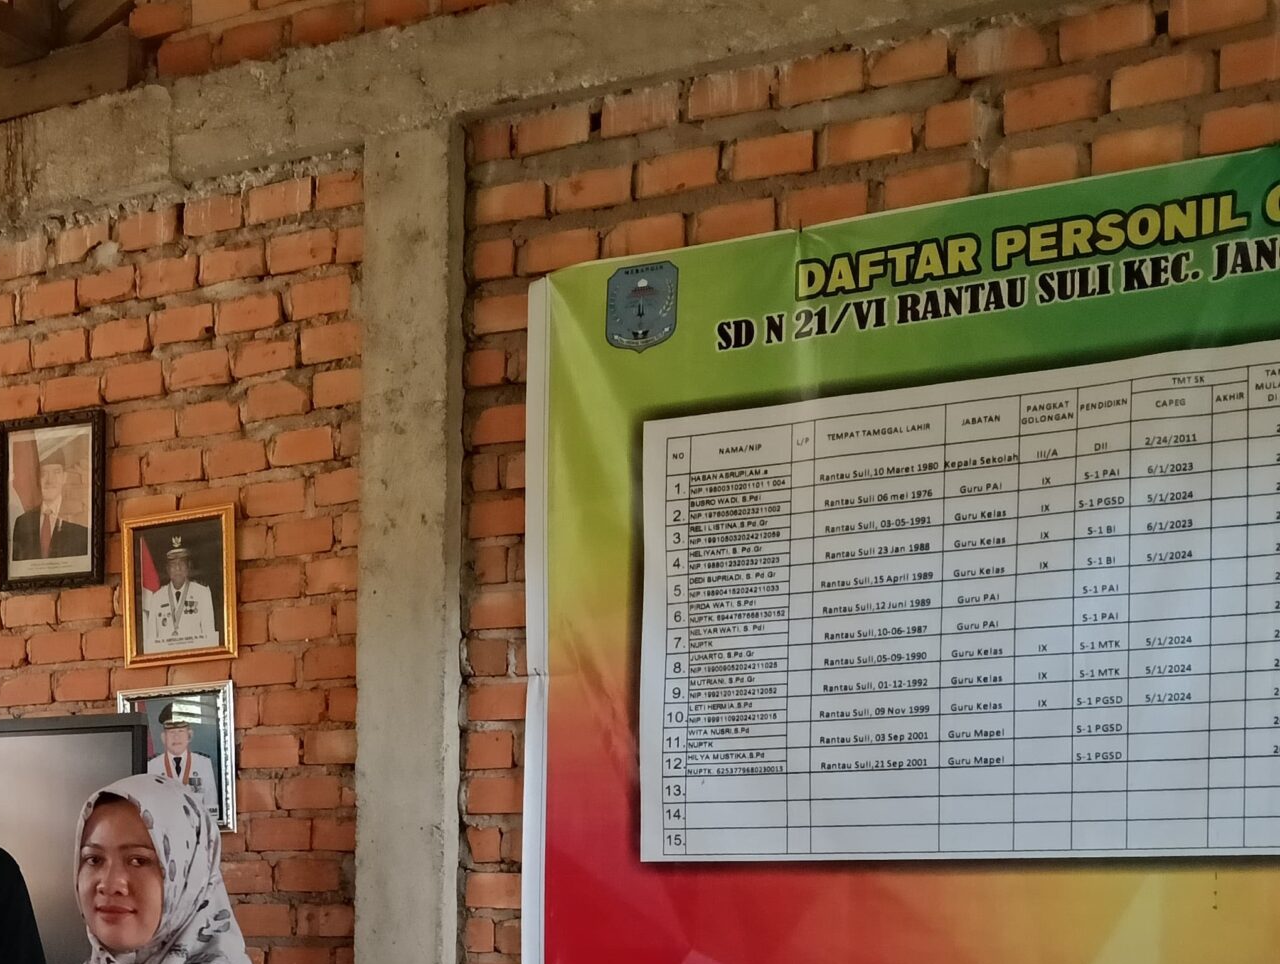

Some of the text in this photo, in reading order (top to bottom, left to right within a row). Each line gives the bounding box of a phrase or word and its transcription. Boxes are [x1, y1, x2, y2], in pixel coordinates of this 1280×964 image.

[797, 235, 979, 299] DAFTAR
[994, 193, 1249, 268] PERSONIL
[717, 318, 755, 350] SD
[766, 314, 784, 343] N
[794, 297, 886, 339] 21/VI
[897, 277, 1026, 324] RANTAU
[1038, 263, 1111, 304] SULI
[1122, 251, 1200, 292] KEC.
[1172, 375, 1205, 384] TMT SK
[1216, 392, 1244, 402] AKHIR
[1027, 401, 1070, 412] PANGKAT
[1155, 399, 1186, 408] CAPEG
[962, 415, 1000, 426] JABATAN
[1021, 412, 1074, 425] GOLONGAN
[827, 431, 859, 441] TEMPAT
[906, 423, 930, 432] LAHIR
[1145, 434, 1197, 446] 2/24/2011
[719, 444, 762, 455] NAMA/NIP
[944, 454, 1018, 469] Kepala Sekolah
[820, 472, 850, 481] Rantau
[887, 466, 914, 475] Maret
[917, 462, 938, 472] 1980
[1148, 462, 1193, 474] 6/1/2023
[960, 485, 982, 494] Guru
[825, 498, 854, 507] Rantau
[858, 495, 875, 504] Suli
[878, 493, 888, 502] 06
[912, 490, 933, 498] 1976
[1097, 496, 1124, 507] PGSD
[1147, 491, 1193, 502] 5/1/2024
[955, 510, 1006, 521] Guru Kelas
[825, 524, 855, 533] Rantau
[880, 516, 931, 528] 03-05-1991
[1147, 519, 1193, 531] 6/1/2023
[954, 537, 1006, 548] Guru Kelas
[825, 551, 855, 560] Rantau
[858, 547, 875, 556] Suli
[909, 542, 930, 551] 1988
[1147, 550, 1193, 562] 5/1/2024
[953, 566, 1005, 578] Guru Kelas
[821, 579, 850, 588] Rantau
[887, 574, 909, 583] April
[912, 572, 933, 580] 1989
[957, 595, 980, 604] Guru
[822, 606, 852, 614] Rantau
[910, 599, 931, 607] 1989
[957, 622, 979, 631] Guru
[824, 632, 854, 640] Rantau
[1146, 636, 1192, 647] 5/1/2024
[1098, 639, 1120, 649] MTK
[951, 647, 1003, 657] Guru Kelas
[824, 658, 854, 666] Rantau
[1098, 668, 1120, 677] MTK
[1145, 664, 1192, 675] 5/1/2024
[951, 674, 1003, 685] Guru Kelas
[823, 684, 853, 693] Rantau
[878, 679, 928, 689] 01-12-1992
[1095, 695, 1123, 705] PGSD
[1145, 692, 1192, 703] 5/1/2024
[820, 710, 850, 718] Rantau
[875, 706, 885, 715] 09
[888, 705, 905, 714] Nov
[909, 705, 929, 714] 1999
[951, 701, 1003, 712] Guru Kelas
[948, 728, 1004, 739] Guru Mapel
[1095, 723, 1122, 733] PGSD
[820, 736, 850, 744] Rantau
[875, 733, 885, 741] 03
[888, 732, 905, 742] Sep
[907, 731, 928, 740] 2001
[948, 755, 1004, 766] Guru Mapel
[1095, 751, 1122, 761] PGSD
[821, 761, 851, 770] Rantau
[887, 758, 903, 769] Sep
[907, 758, 927, 767] 2001
[665, 785, 685, 796] 13.
[666, 808, 685, 820] 14.
[666, 835, 686, 846] 15.
